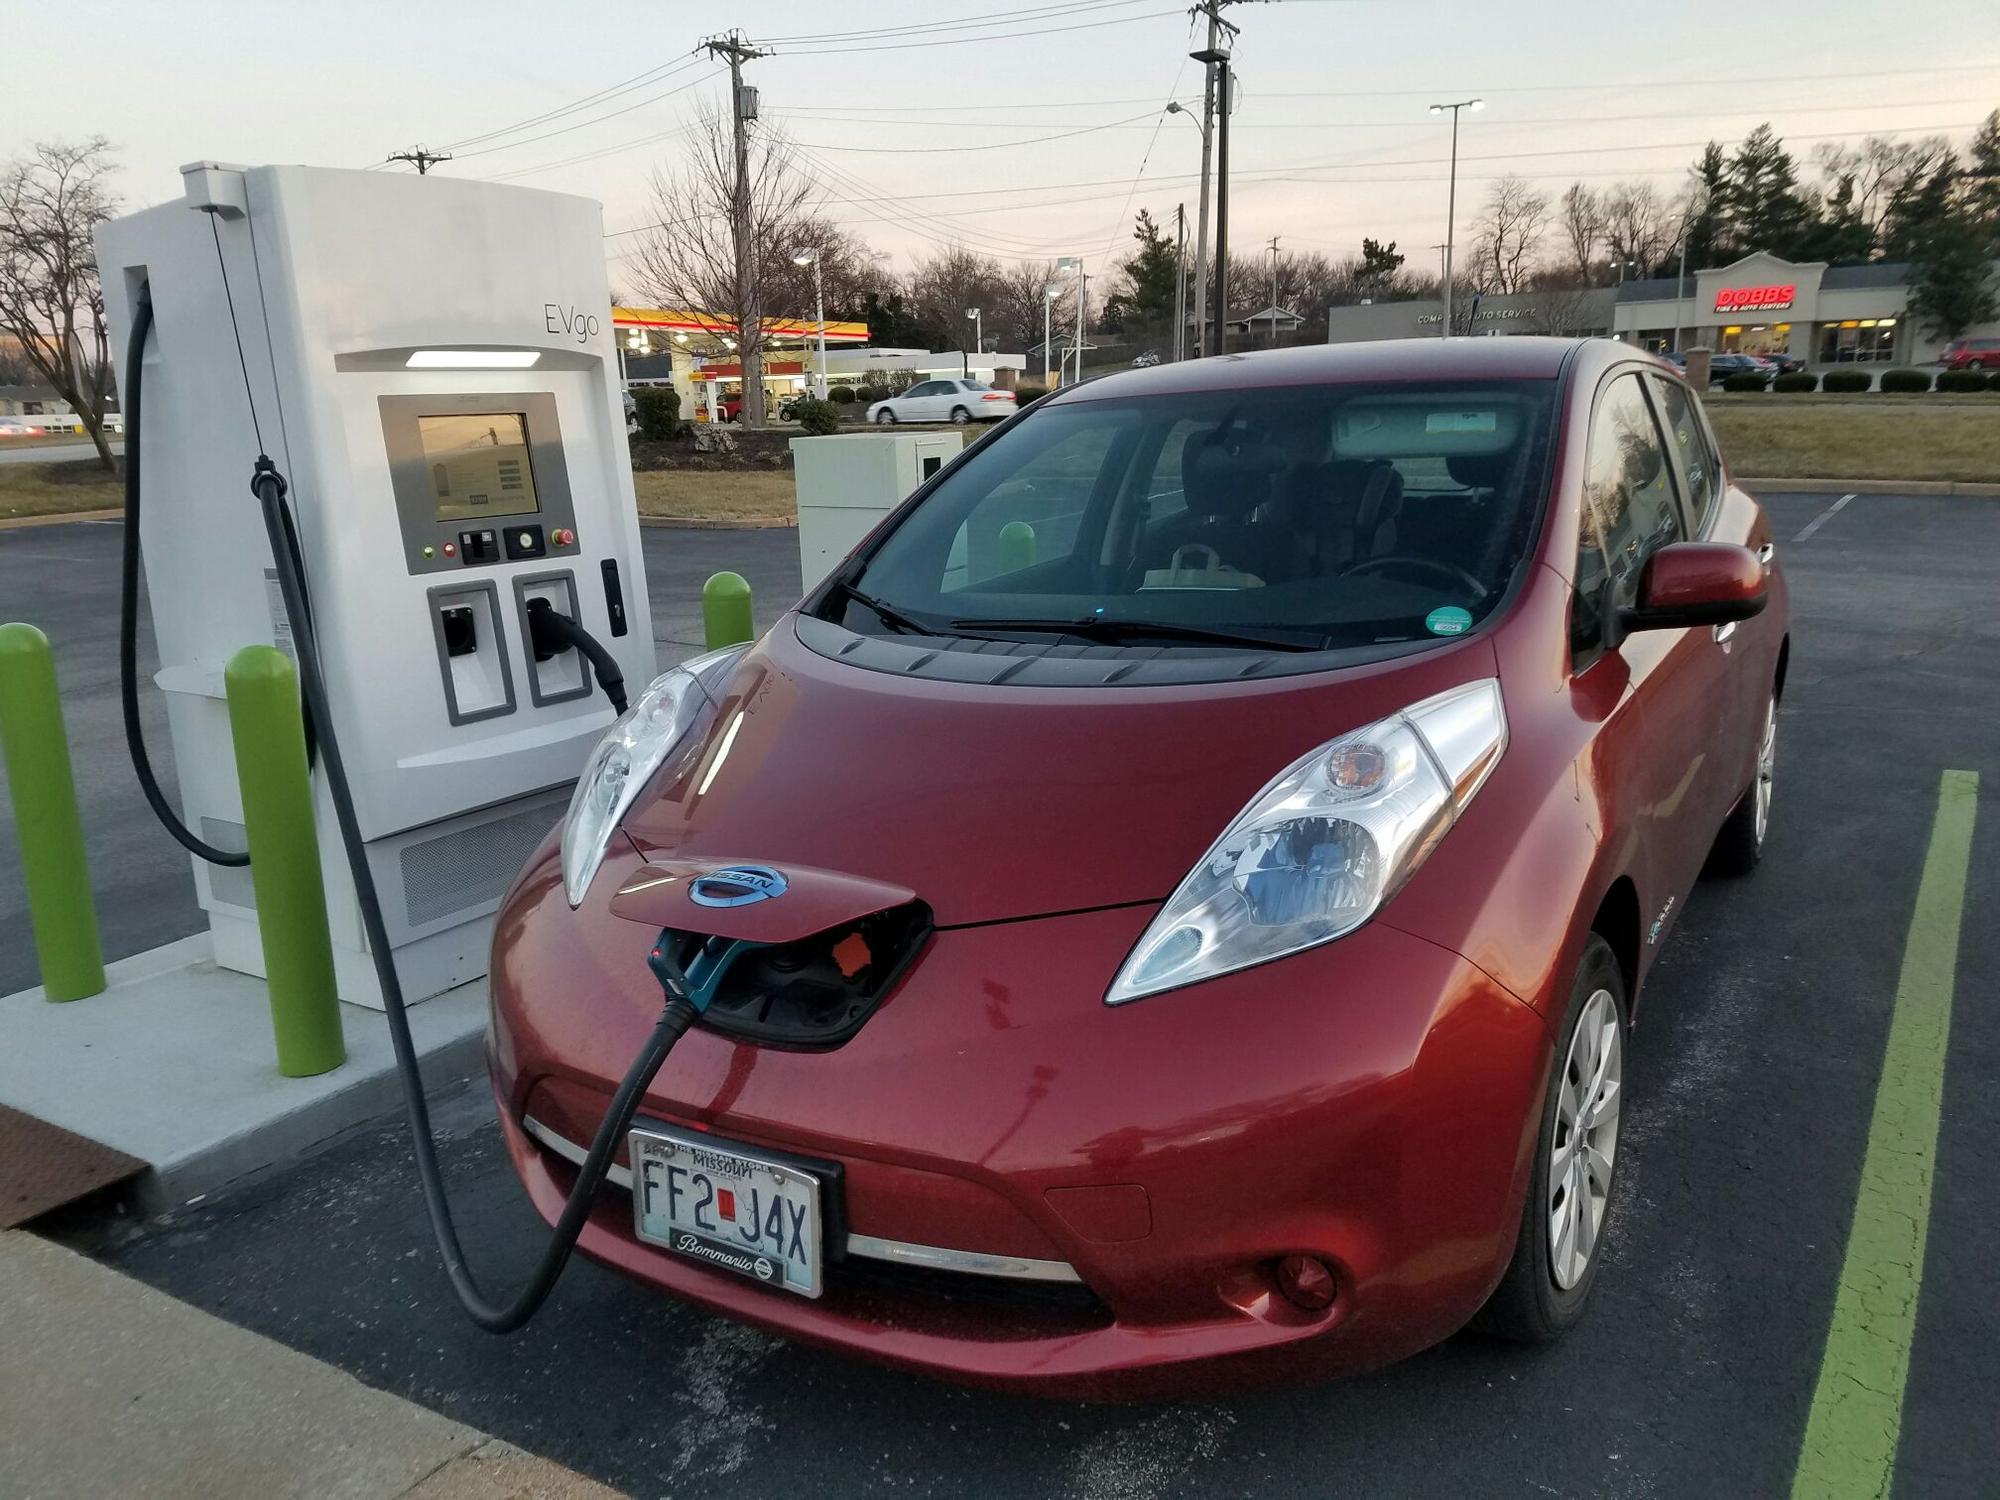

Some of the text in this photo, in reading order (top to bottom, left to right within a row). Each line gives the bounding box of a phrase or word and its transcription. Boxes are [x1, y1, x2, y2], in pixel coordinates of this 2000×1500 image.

[1717, 286, 1794, 306] DOBBS
[545, 304, 599, 344] EVgo
[1496, 307, 1537, 319] SERVICE
[700, 871, 774, 889] NISSAN
[693, 1152, 753, 1179] Missouri
[642, 1159, 807, 1266] FF2 J4X
[677, 1234, 753, 1271] Bommarito
